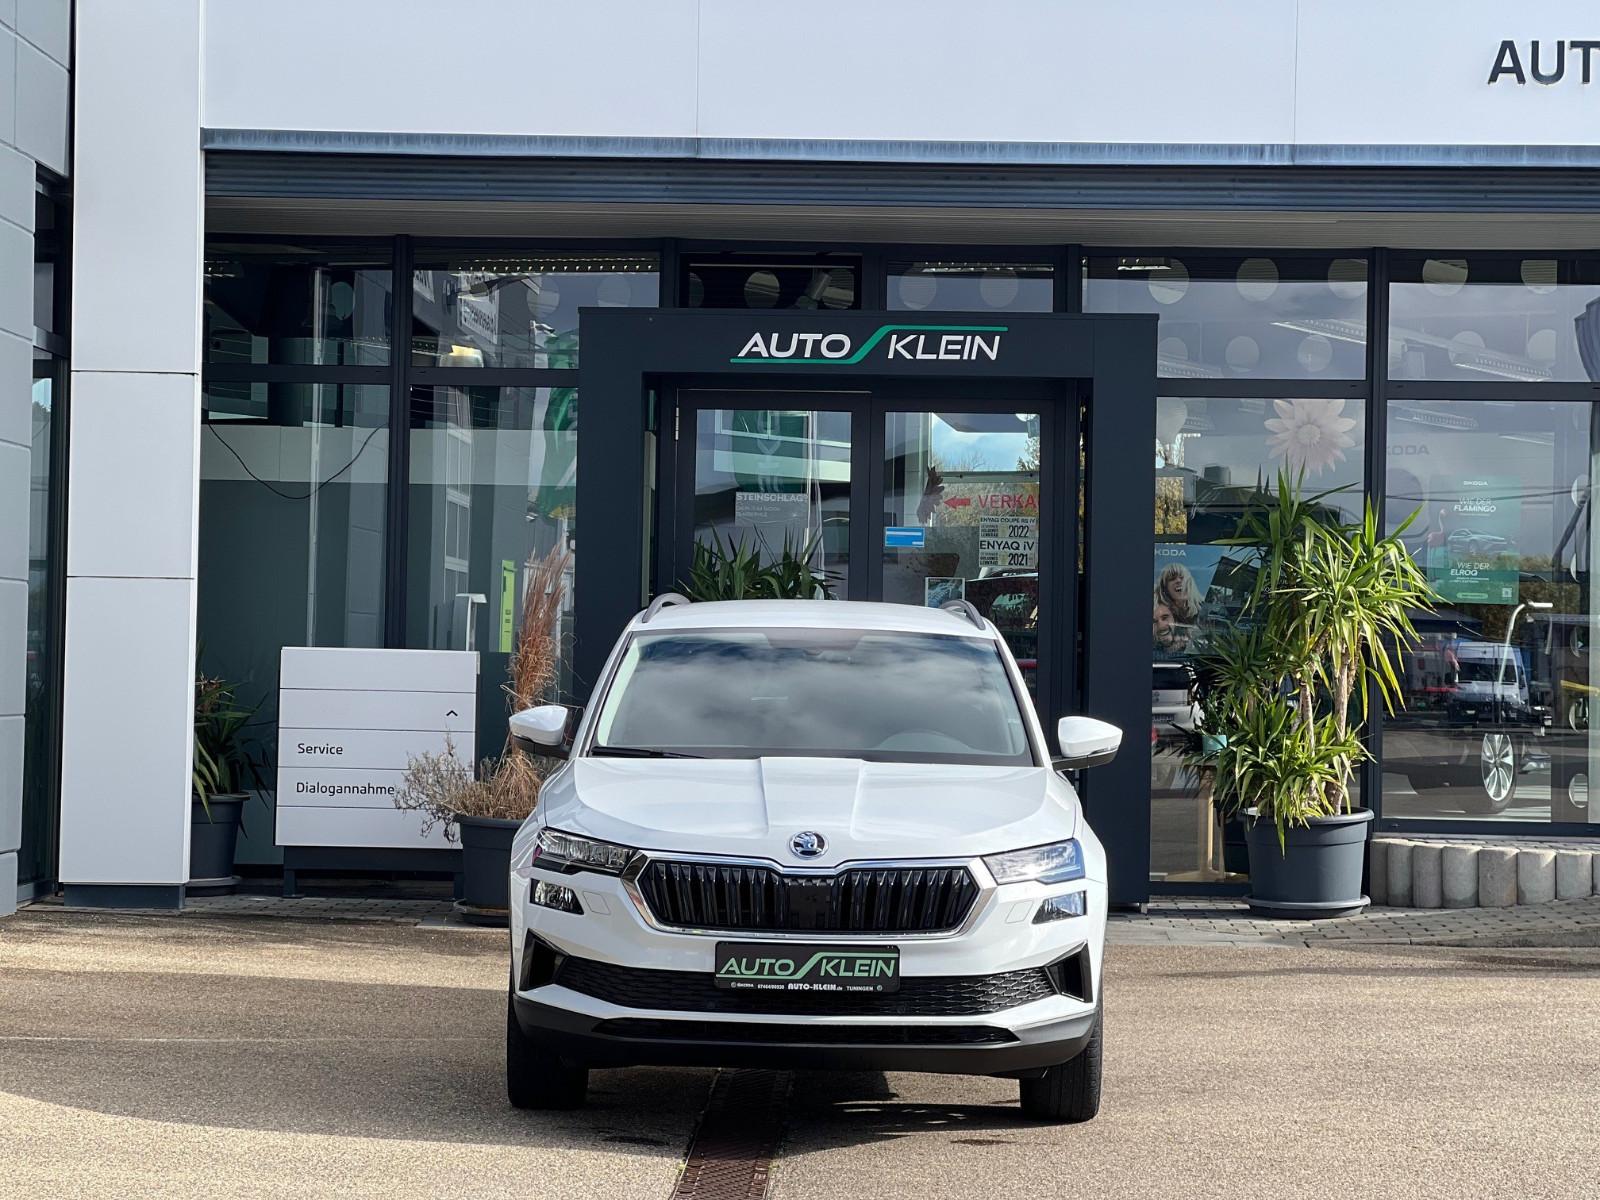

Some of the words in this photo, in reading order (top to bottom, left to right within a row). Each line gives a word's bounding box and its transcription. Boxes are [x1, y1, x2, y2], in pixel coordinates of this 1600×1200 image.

[1487, 40, 1600, 85] AUT
[738, 332, 850, 358] AUTO
[887, 334, 1000, 361] KLEIN
[1454, 504, 1497, 513] FLAMINGO
[1008, 525, 1030, 538] 2022
[979, 540, 1020, 551] ENYAQ
[1023, 541, 1035, 551] iV
[1008, 553, 1029, 566] 2021
[1473, 562, 1490, 570] DER
[1450, 568, 1478, 576] ELROQ
[297, 743, 344, 755] Service
[296, 782, 395, 796] Dialogannahme
[720, 958, 796, 976] AUTO
[820, 959, 895, 978] KLEIN
